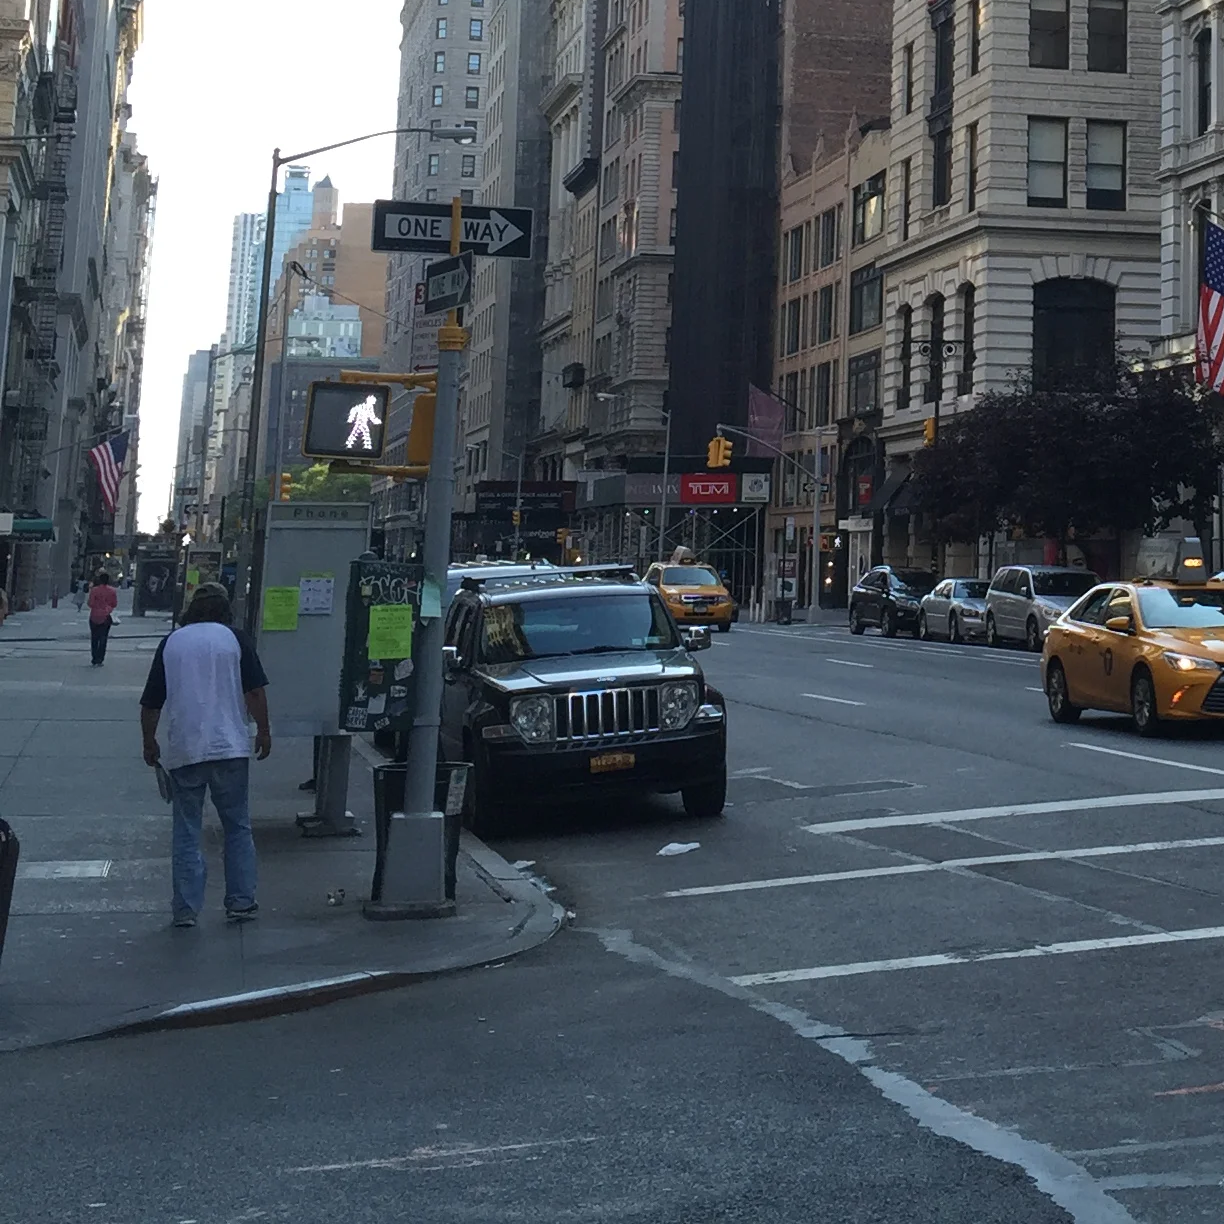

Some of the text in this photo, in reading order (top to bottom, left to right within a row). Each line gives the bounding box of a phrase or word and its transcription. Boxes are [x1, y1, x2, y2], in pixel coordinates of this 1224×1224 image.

[397, 217, 509, 242] ONE WAY
[688, 482, 729, 495] TUMI
[293, 508, 350, 519] Phone
